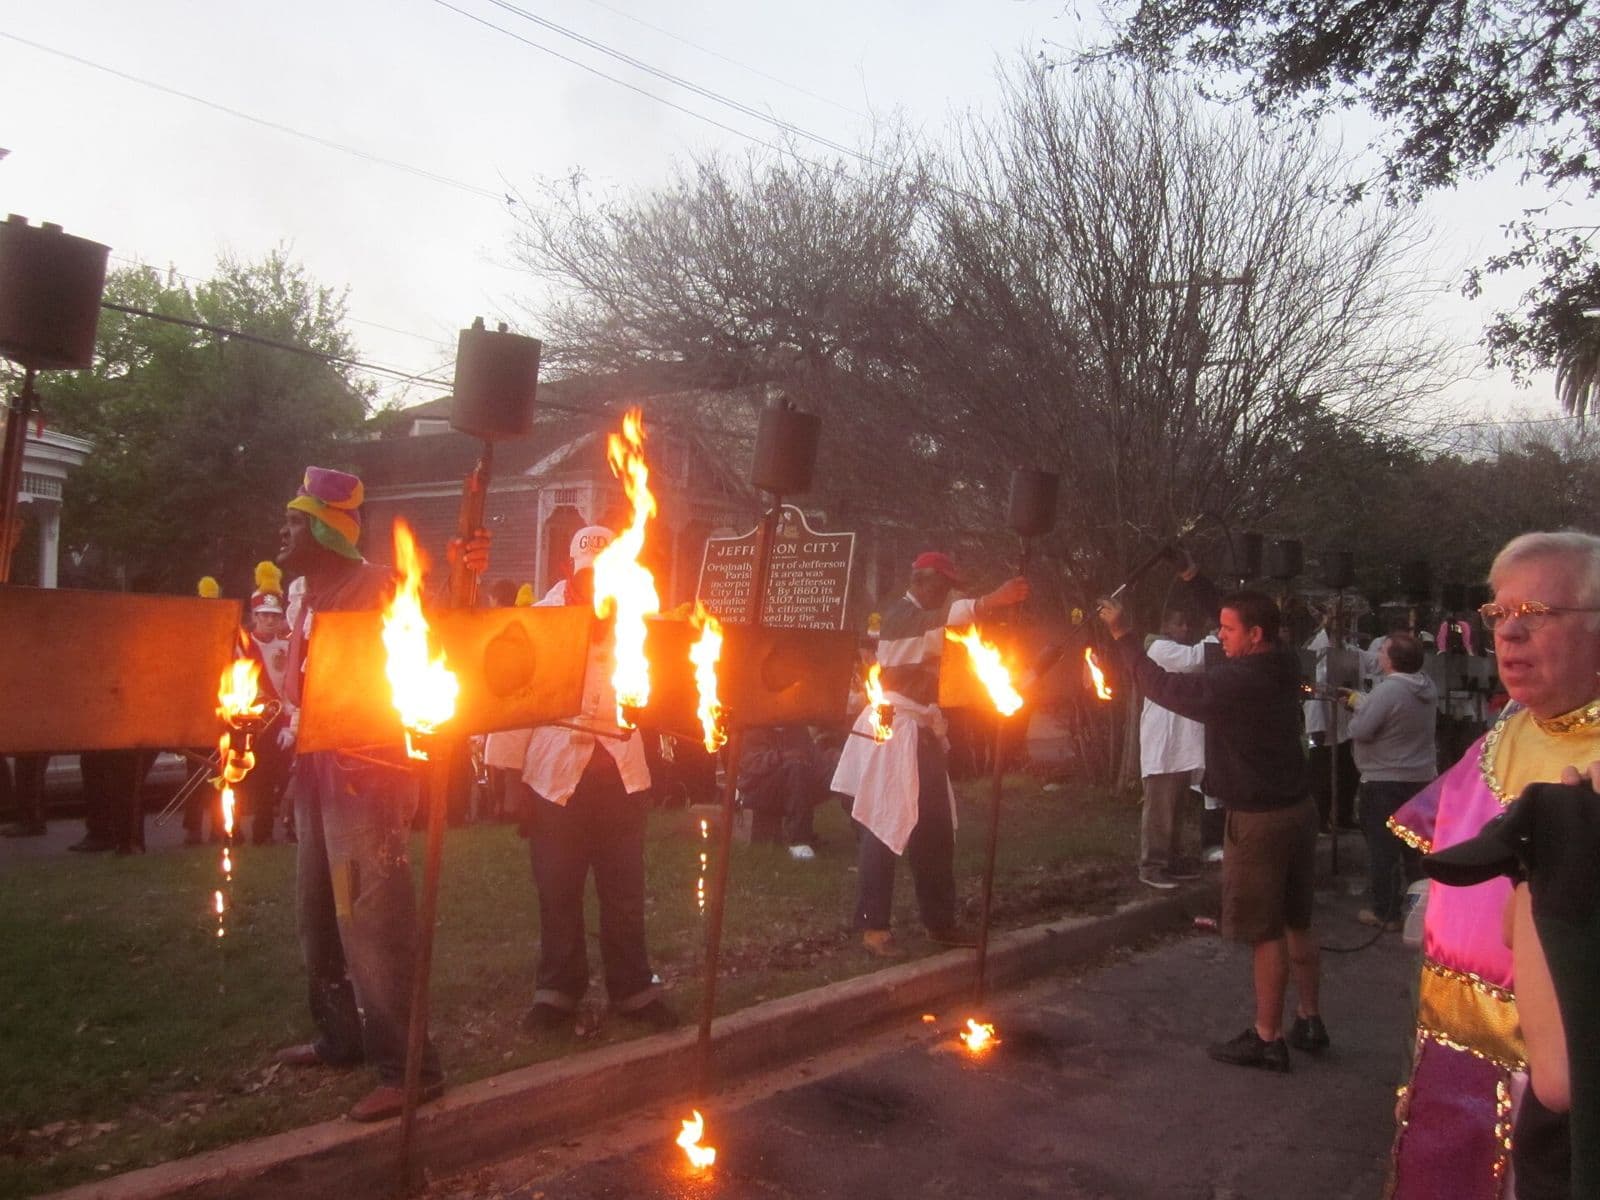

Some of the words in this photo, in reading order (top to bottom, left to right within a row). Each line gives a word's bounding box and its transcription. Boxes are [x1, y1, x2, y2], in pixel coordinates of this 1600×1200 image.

[717, 543, 797, 557] JEFFEON
[803, 542, 840, 553] CITY
[770, 562, 786, 570] art
[787, 560, 798, 569] of
[798, 560, 846, 569] Jefferson
[781, 570, 804, 578] area
[788, 577, 836, 587] Jefferson
[778, 586, 791, 598] By
[793, 586, 819, 595] 1860
[796, 595, 841, 606] including
[725, 605, 746, 614] free
[783, 613, 796, 624] by
[798, 613, 815, 622] the
